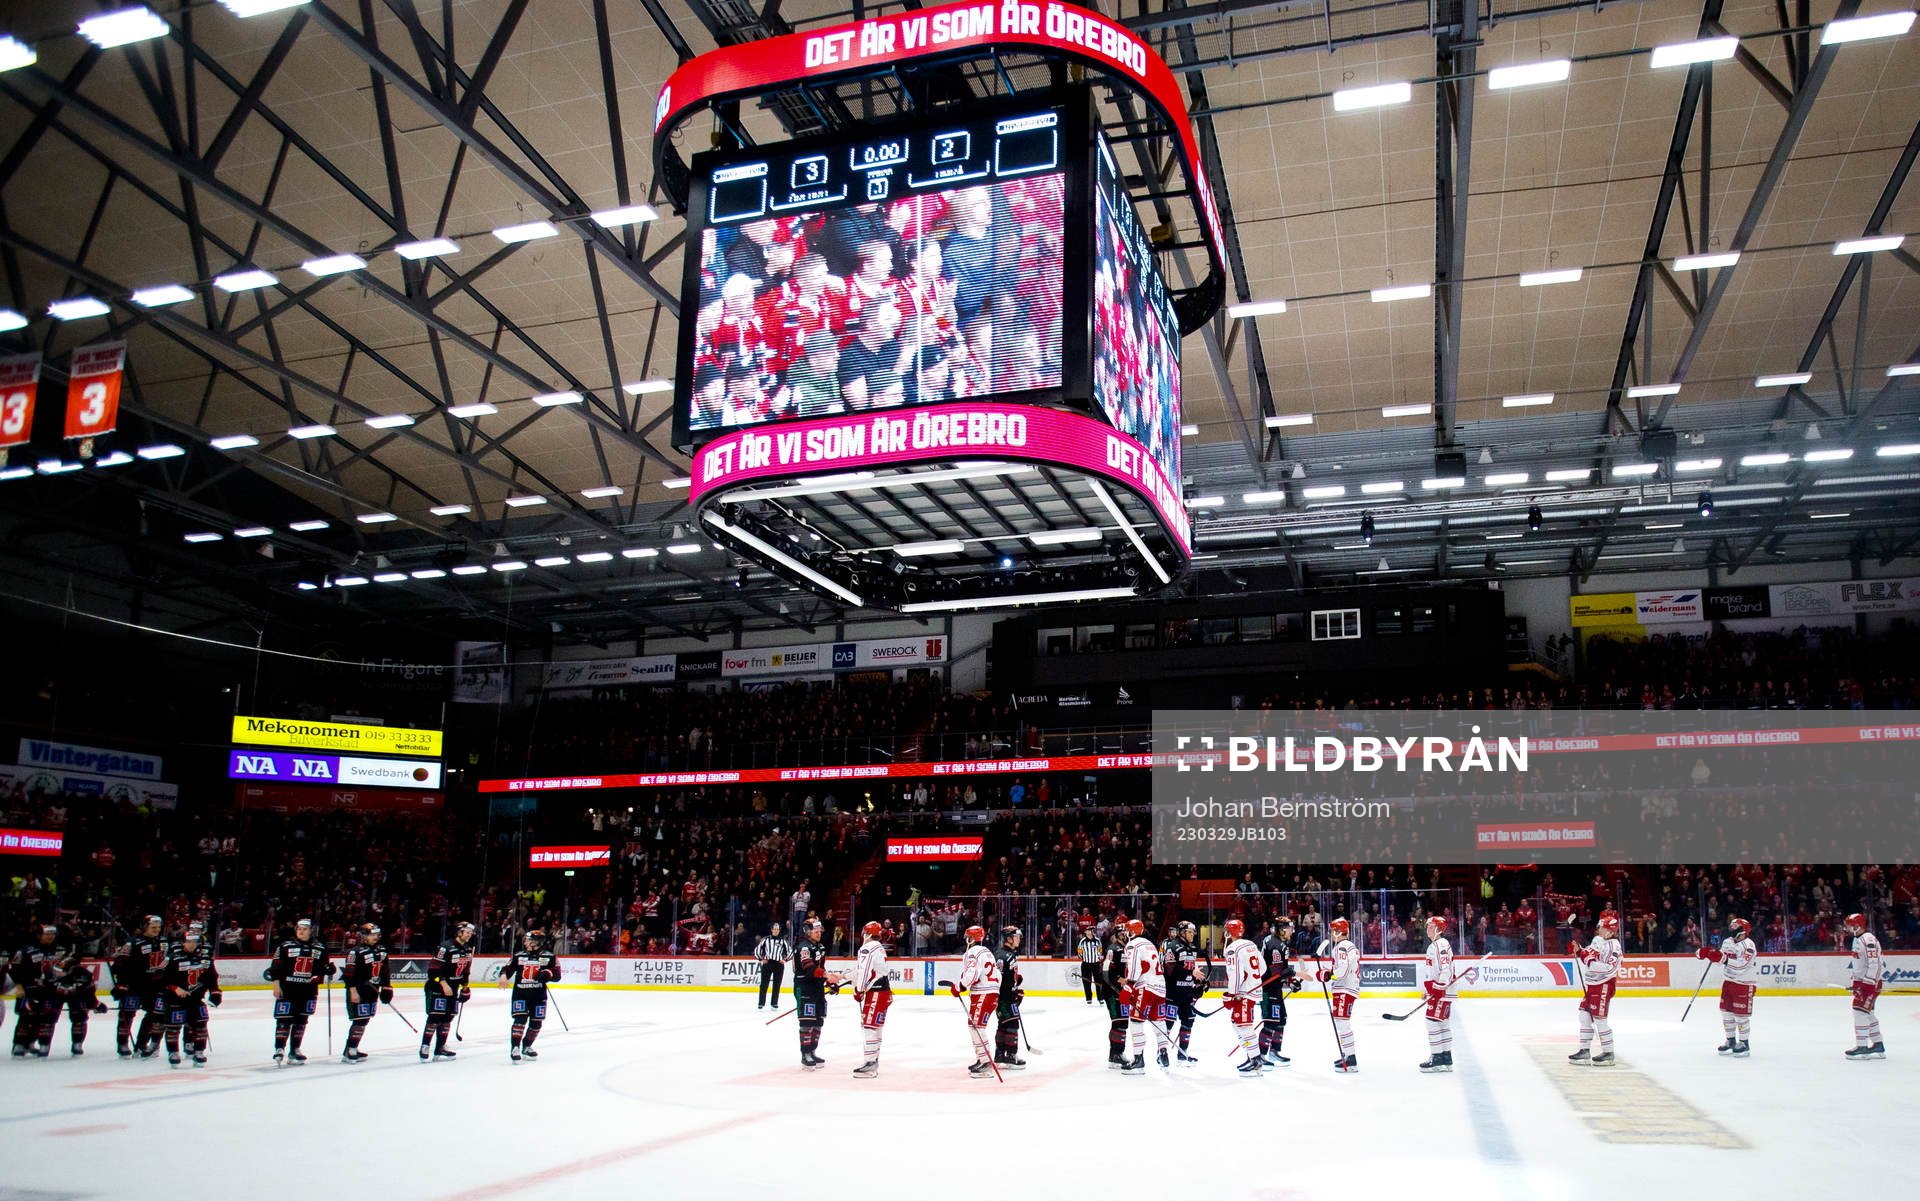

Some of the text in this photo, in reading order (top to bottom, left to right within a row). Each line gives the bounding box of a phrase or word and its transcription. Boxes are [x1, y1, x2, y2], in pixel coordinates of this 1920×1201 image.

[805, 30, 856, 68] DET
[860, 21, 896, 58] ÄR
[901, 22, 927, 51] VI
[932, 5, 994, 45] SOM
[1046, 2, 1147, 77] ÖREBRO
[864, 143, 900, 163] 0.00
[941, 139, 955, 158] 2
[806, 162, 818, 181] 3
[80, 382, 106, 426] 3
[703, 413, 1027, 483] DET ÄR VI SOM ÄR ÖREBRO
[1106, 434, 1140, 479] DET
[1842, 582, 1904, 602] FLEX
[1710, 593, 1744, 606] make
[1639, 605, 1696, 613] Weidermans
[1728, 600, 1763, 613] brand
[784, 652, 816, 661] BEIJER
[835, 652, 854, 662] CAB
[873, 646, 917, 657] SWEROCK
[361, 657, 444, 680] In Frigore
[632, 663, 674, 675] Sealift
[680, 662, 718, 671] SNICKARE
[725, 657, 766, 670] four fm
[247, 719, 432, 743] Mekonomen 019 33 33 33
[1860, 728, 1881, 739] DET
[1656, 736, 1676, 746] DET
[1697, 733, 1708, 744] VI
[1710, 732, 1736, 744] SOM
[1755, 731, 1800, 743] ÖREBRO
[29, 741, 154, 774] Vintergatan
[1098, 756, 1115, 767] DET
[235, 756, 332, 778] NA NA
[351, 767, 410, 779] Swedbank
[933, 764, 950, 774] DET
[966, 763, 974, 773] VI
[976, 762, 997, 773] SOM
[781, 769, 796, 779] DET
[811, 768, 819, 778] VI
[821, 768, 840, 778] SOM
[640, 775, 655, 785] DET
[1478, 831, 1495, 842] DET
[1511, 832, 1520, 841] VI
[888, 846, 902, 855] DET
[923, 845, 940, 854] SOM
[634, 962, 683, 972] KLUBB
[1483, 966, 1518, 975] Thermia
[1616, 965, 1656, 978] enta
[634, 974, 695, 984] TEAMET
[1362, 969, 1403, 980] upfront
[1484, 974, 1544, 985] Värmepumpar
[1775, 976, 1796, 984] group
